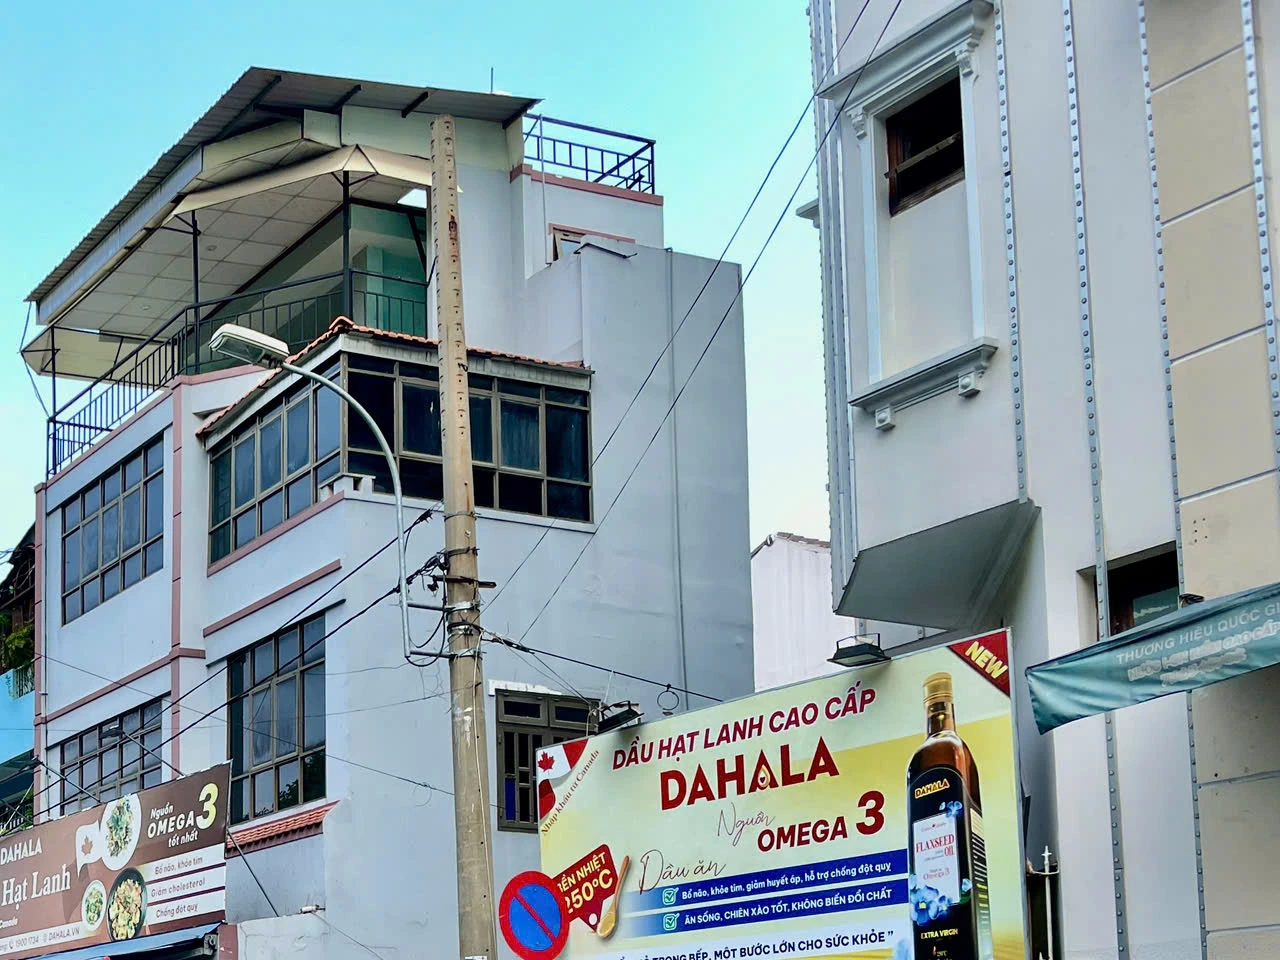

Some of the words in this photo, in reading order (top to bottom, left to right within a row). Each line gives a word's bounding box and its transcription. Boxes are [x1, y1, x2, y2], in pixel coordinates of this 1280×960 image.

[1116, 637, 1175, 664] THƯƠNG
[1218, 609, 1260, 632] QUỐC
[965, 641, 1008, 679] NEW
[613, 736, 654, 770] DẦU
[658, 731, 700, 762] HẠT
[704, 715, 764, 749] LANH
[770, 703, 819, 733] CAO
[825, 681, 876, 720] CẤP
[576, 749, 601, 783] Canada
[660, 736, 840, 811] DAHALA
[915, 778, 950, 799] DAHALA
[147, 810, 195, 838] OMEGA
[196, 783, 219, 830] 3
[757, 816, 848, 852] OMEGA
[856, 790, 885, 835] 3
[0, 837, 42, 865] DAHALA
[168, 834, 179, 847] tốt
[180, 827, 198, 845] nhất
[916, 834, 955, 853] FLAXSEED
[576, 851, 606, 882] NHIỆT
[682, 888, 693, 900] Bổ
[693, 888, 710, 899] não,
[730, 882, 745, 893] tim,
[746, 879, 766, 893] giảm
[766, 874, 790, 889] huyết
[790, 875, 803, 888] áp,
[817, 869, 830, 881] trợ
[831, 865, 857, 878] chống
[858, 863, 873, 874] đột
[693, 859, 727, 877] ăn
[1, 877, 28, 910] Hạt
[31, 863, 70, 899] Lanh
[169, 877, 206, 893] cholesterol
[685, 915, 697, 926] ĂN
[697, 910, 722, 925] SỐNG,
[724, 906, 750, 920] CHIÊN
[751, 904, 769, 916] XÀO
[771, 899, 790, 914] TỐT,
[791, 896, 824, 912] KHÔNG
[825, 889, 846, 907] BIẾN
[848, 888, 866, 903] ĐỔI
[866, 885, 893, 901] CHẤT
[740, 942, 770, 957] BƯỚC
[773, 940, 795, 954] LỚN
[798, 938, 823, 951] CHO
[825, 934, 849, 948] SỨC
[852, 929, 885, 945] KHỎE
[920, 930, 939, 939] EXTRA
[939, 928, 958, 937] VIRGIN
